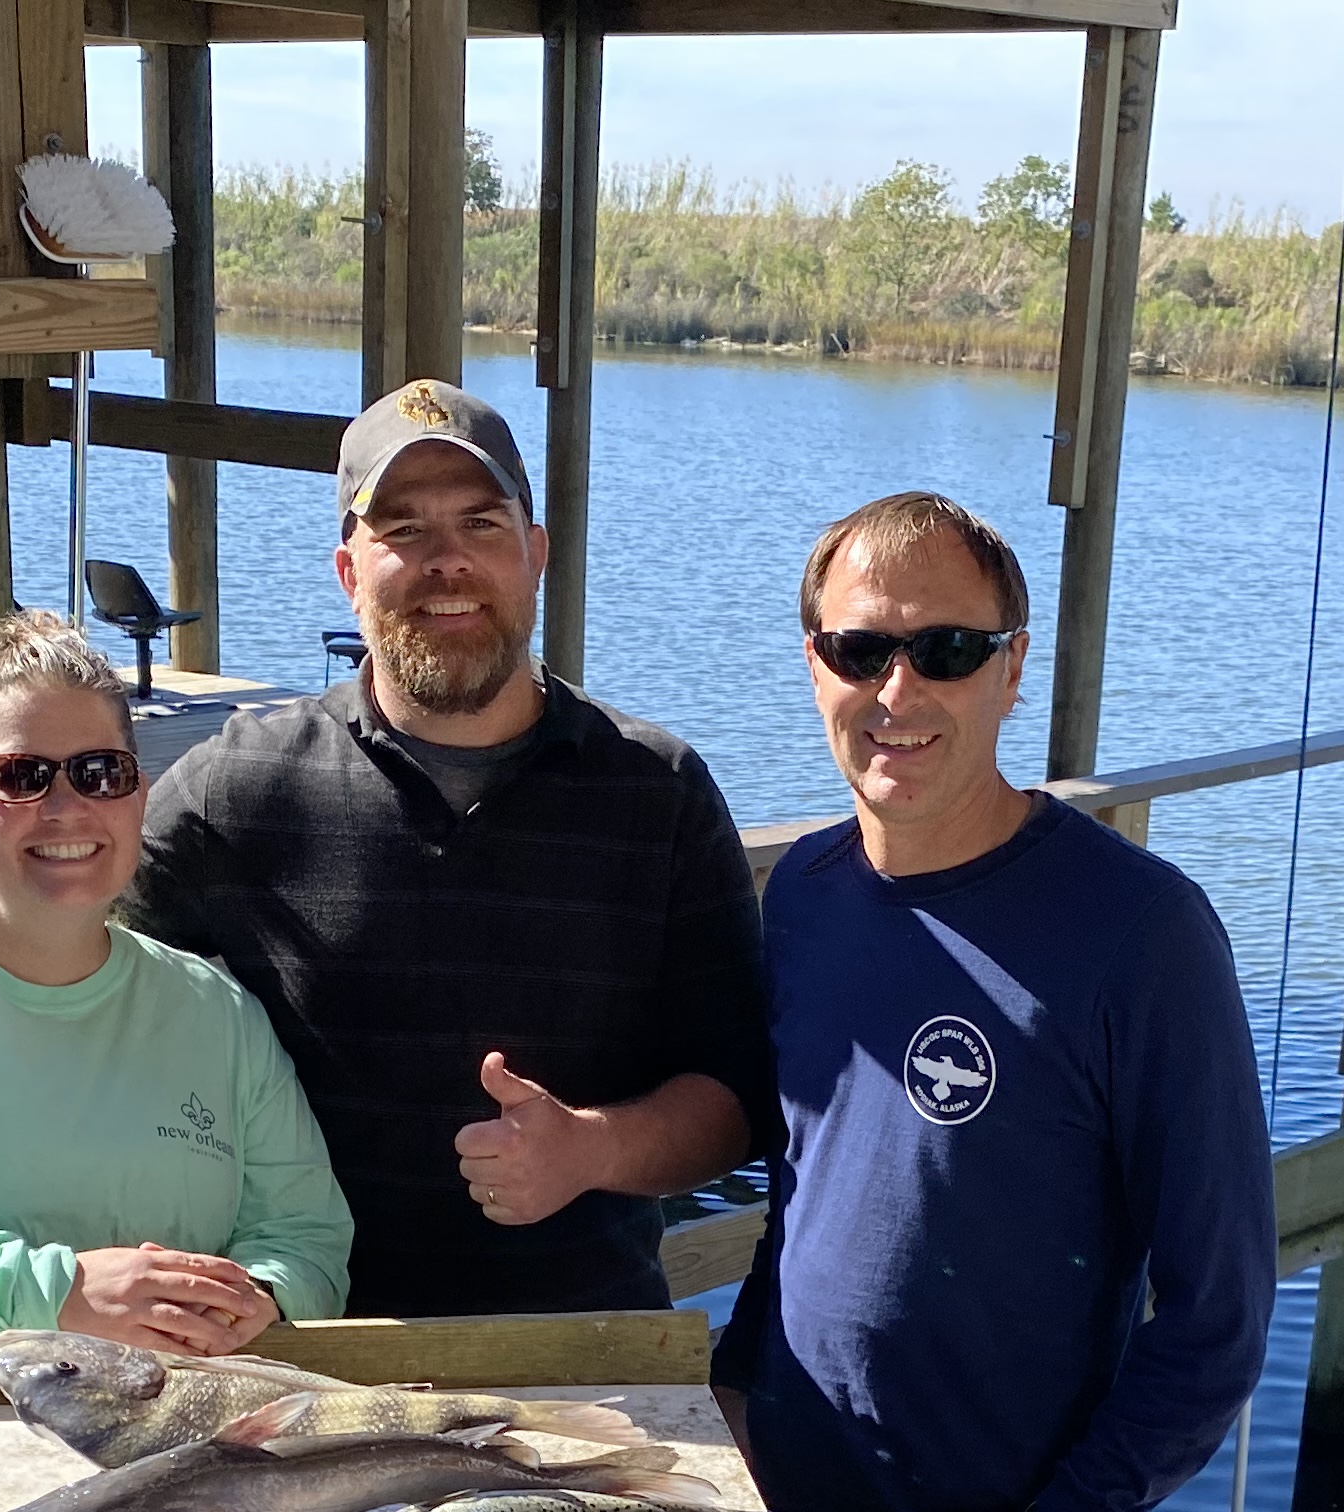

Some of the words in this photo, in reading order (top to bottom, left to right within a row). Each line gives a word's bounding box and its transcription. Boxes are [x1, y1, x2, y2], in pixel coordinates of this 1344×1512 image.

[916, 1030, 942, 1054] USCGC
[941, 1028, 964, 1041] SPAR
[939, 1099, 971, 1113] ALASKA
[156, 1125, 191, 1141] new
